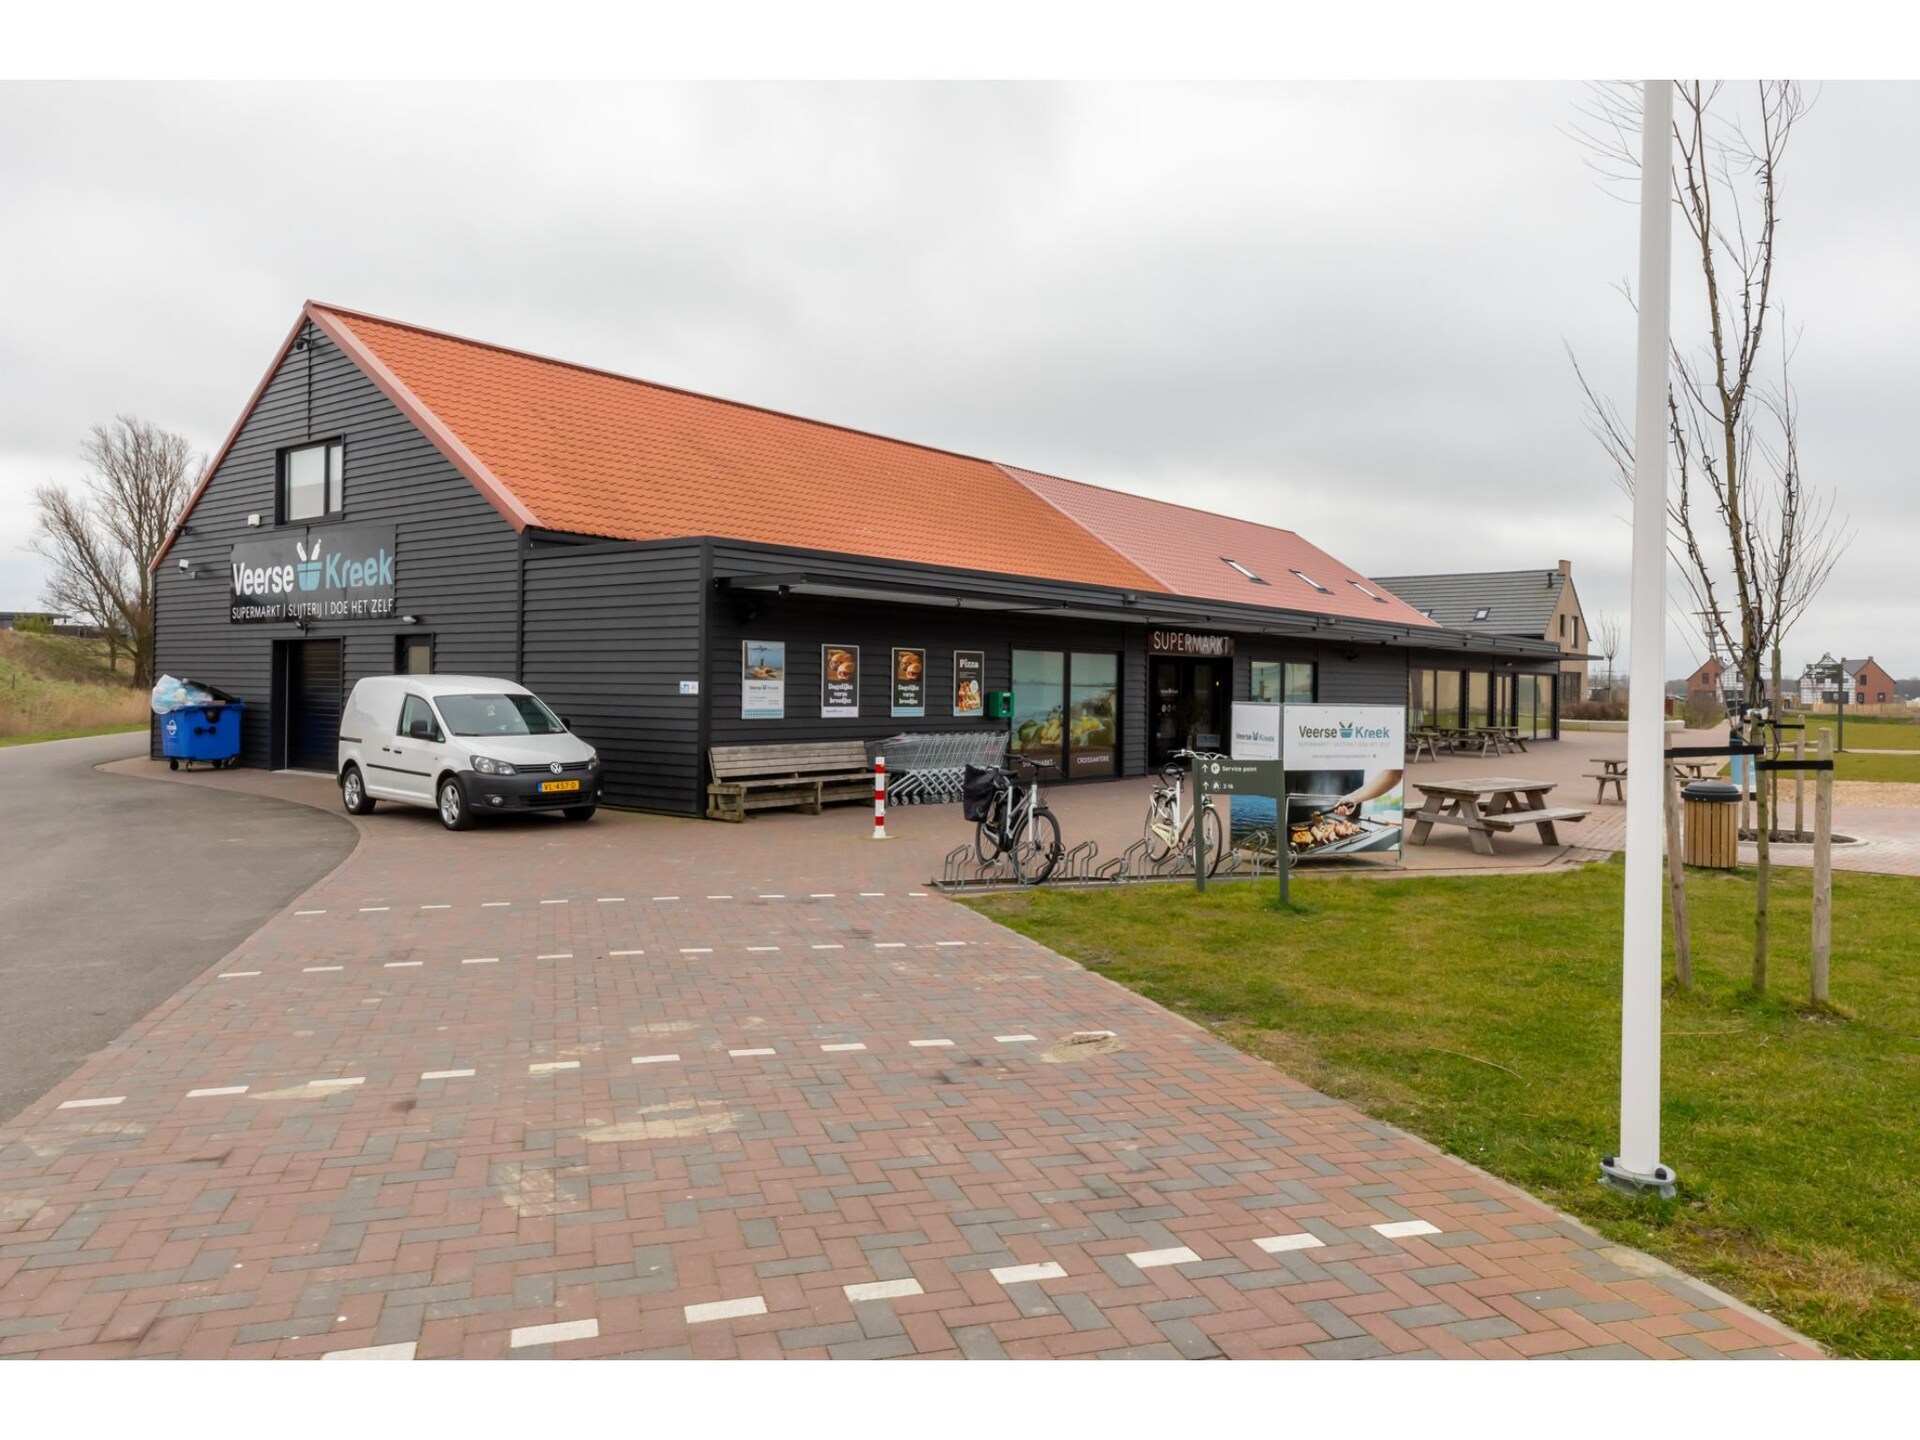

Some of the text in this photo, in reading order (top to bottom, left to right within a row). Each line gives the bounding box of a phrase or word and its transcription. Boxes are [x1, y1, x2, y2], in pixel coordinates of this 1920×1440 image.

[232, 548, 394, 596] Veerse Kreek
[231, 598, 394, 620] SUPERMARKT SLIJTERIJ DOE HET ZELF
[1153, 630, 1230, 655] SUPERMARKT
[959, 658, 979, 668] Pizza
[1298, 725, 1390, 739] Veerse Kreek
